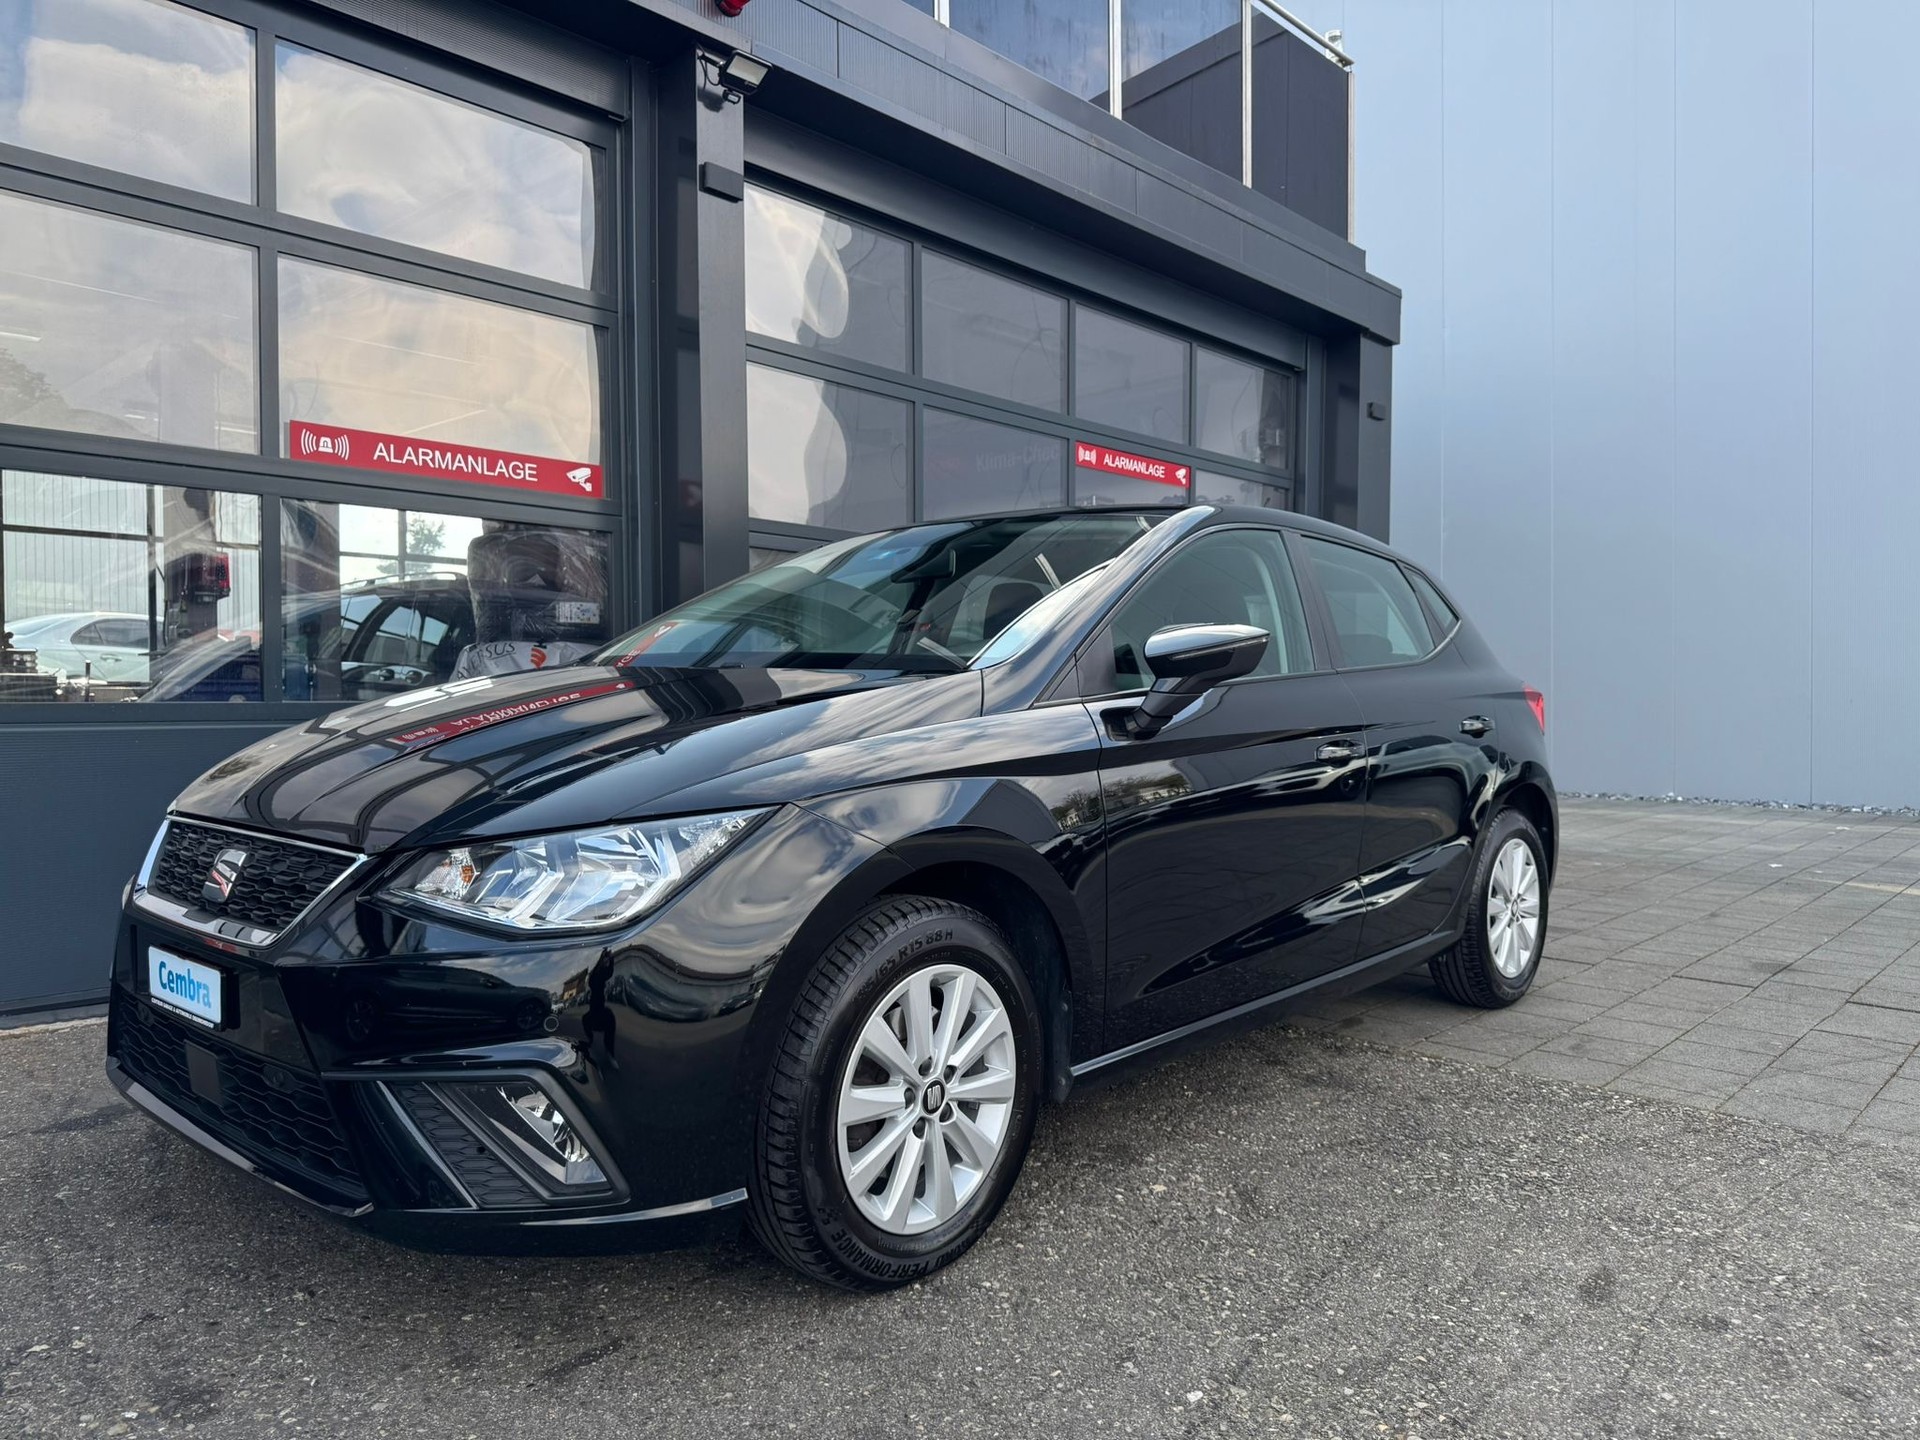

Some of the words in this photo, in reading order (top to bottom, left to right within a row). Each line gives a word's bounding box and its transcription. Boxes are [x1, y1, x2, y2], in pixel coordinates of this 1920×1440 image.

[373, 442, 538, 482] ALARMANLAGE
[1103, 453, 1166, 478] ALARMANLAGE
[159, 961, 211, 1008] Cembra
[831, 1228, 930, 1279] PERFORMANCE
